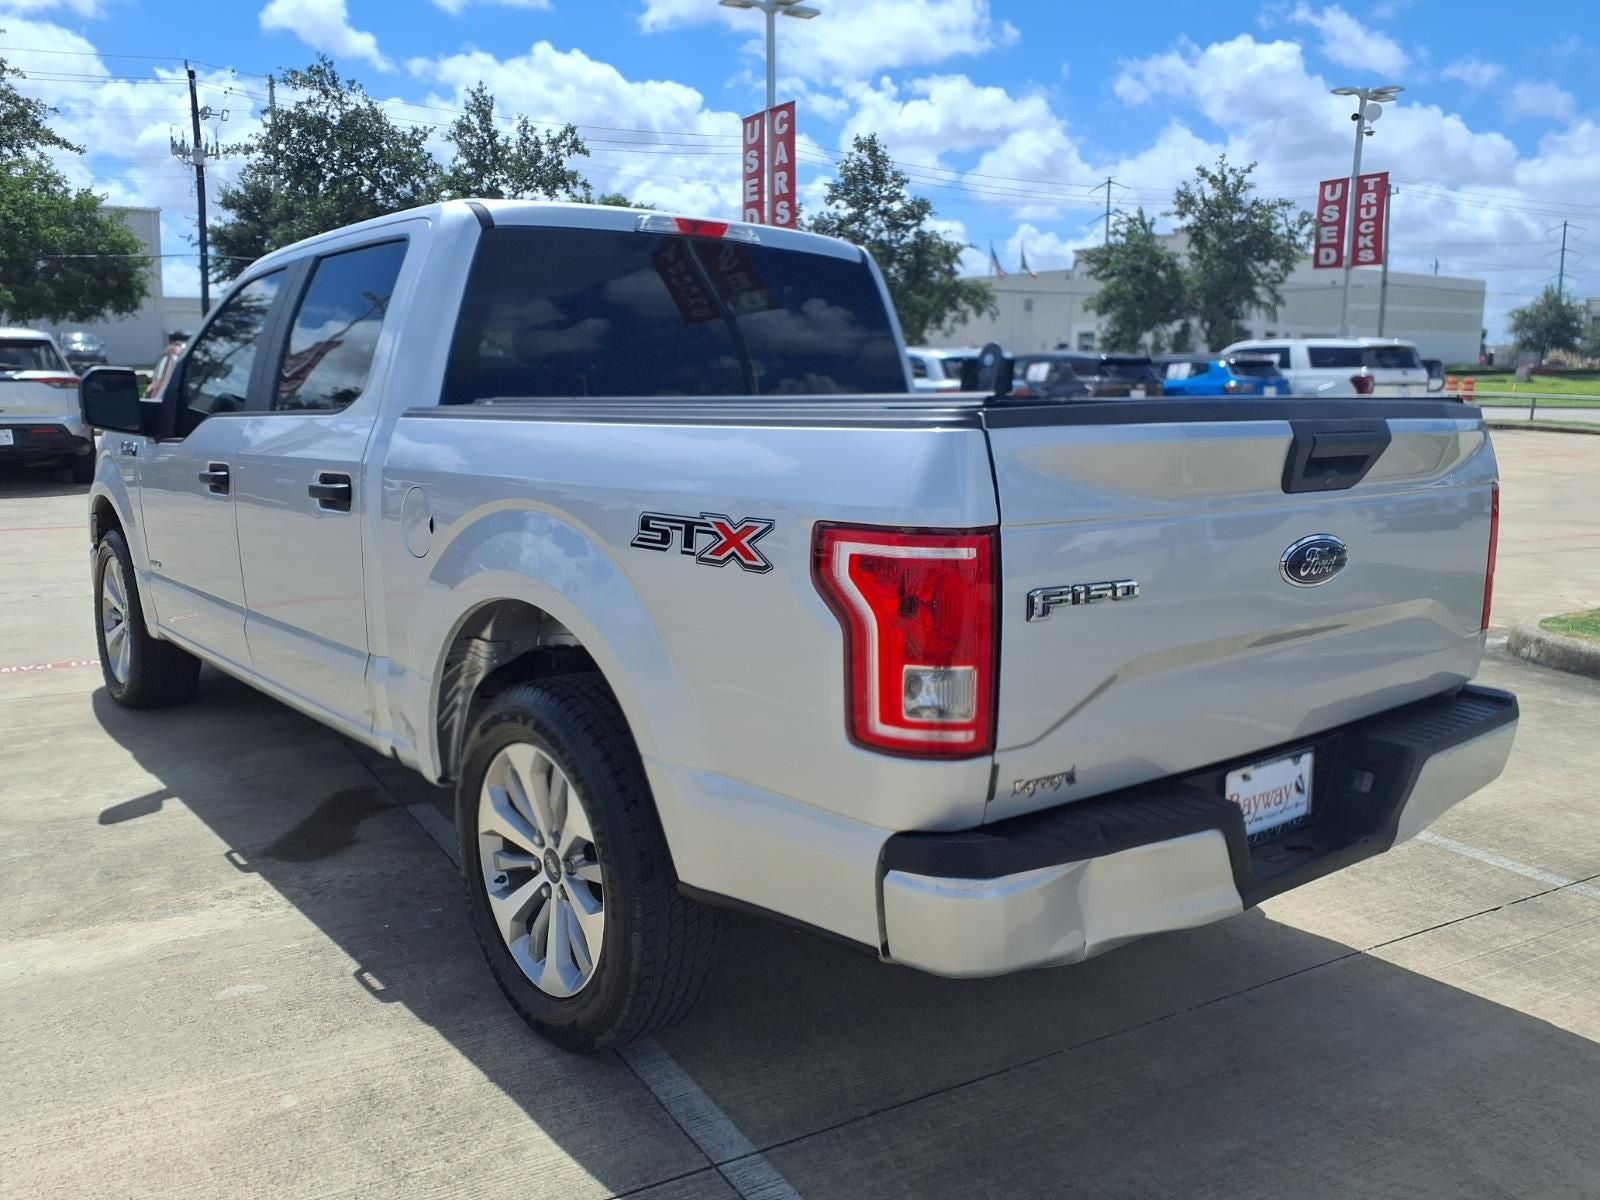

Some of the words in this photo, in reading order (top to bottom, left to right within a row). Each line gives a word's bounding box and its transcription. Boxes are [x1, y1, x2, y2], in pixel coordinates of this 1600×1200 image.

[744, 119, 760, 224] USED
[774, 110, 791, 225] CARS
[1318, 183, 1343, 266] USED
[1357, 177, 1381, 263] TRUCKS
[630, 511, 776, 575] STX
[1026, 579, 1140, 622] F150
